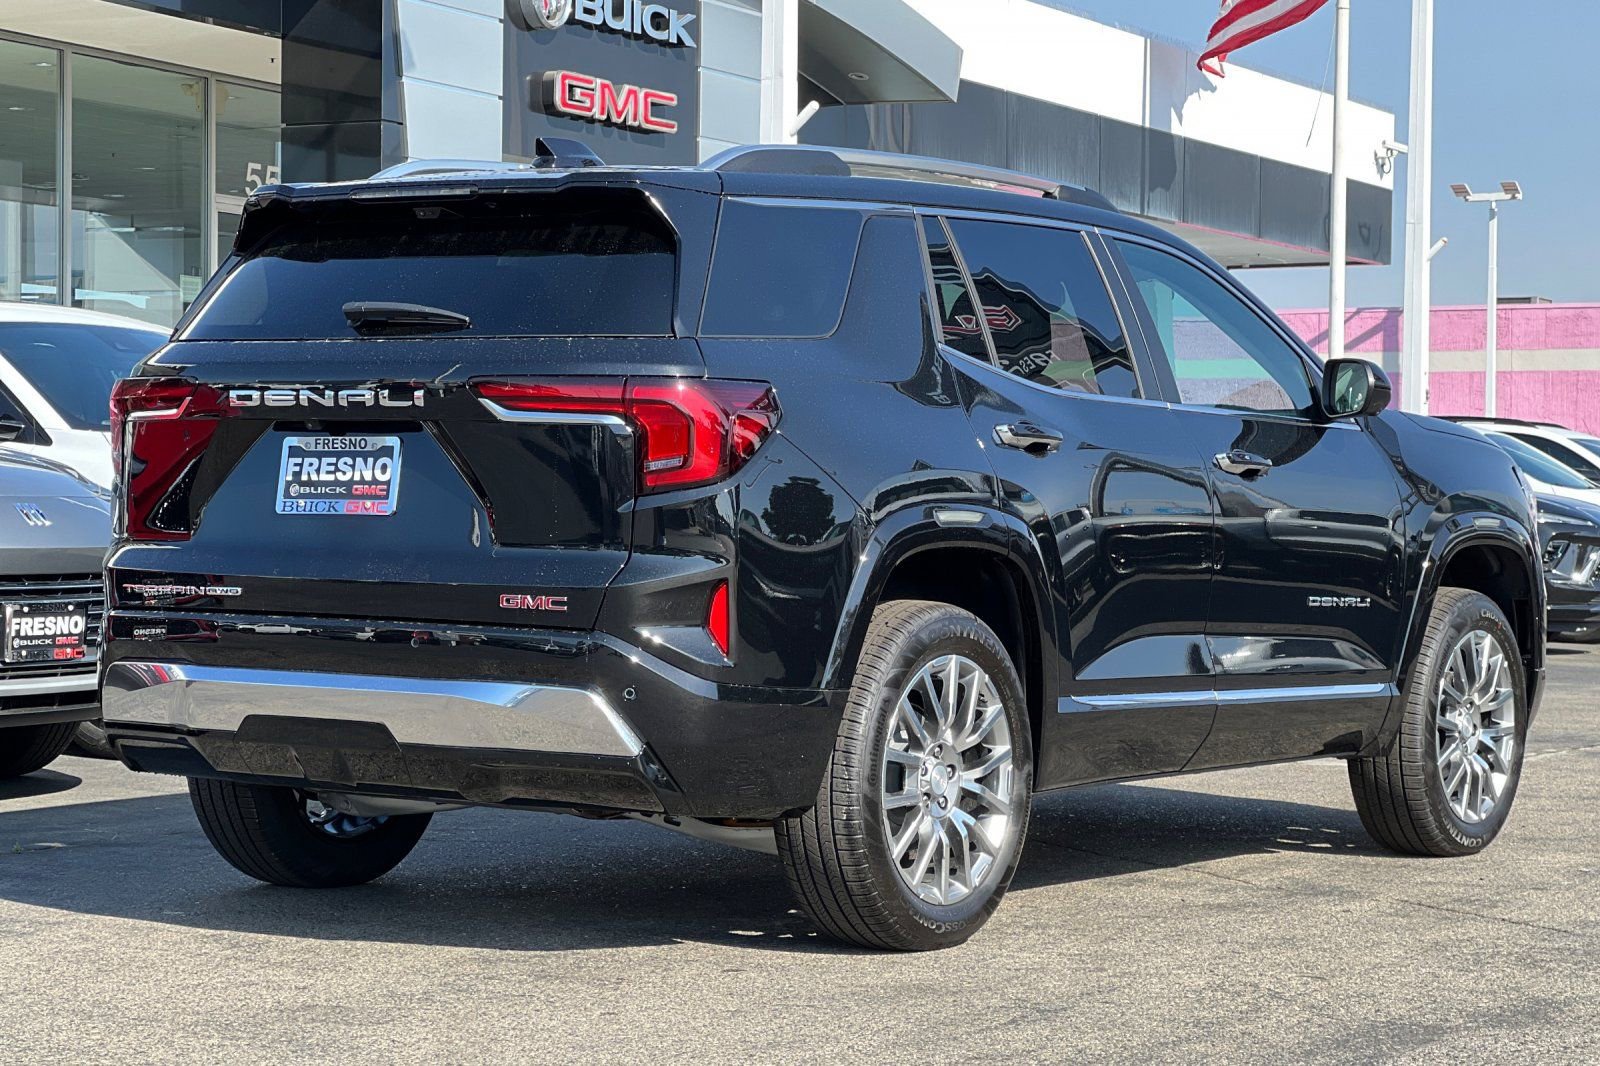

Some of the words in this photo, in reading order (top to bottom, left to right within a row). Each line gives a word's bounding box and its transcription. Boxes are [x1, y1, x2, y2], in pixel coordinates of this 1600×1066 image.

[575, 0, 697, 48] BUICK
[556, 70, 678, 134] GMC
[229, 389, 425, 407] DENALI
[314, 437, 368, 450] FRESNO
[286, 457, 393, 481] FRESNO
[300, 486, 347, 495] BUICK
[352, 484, 387, 496] GMC
[281, 500, 339, 513] BUICK
[343, 501, 389, 514] GMC
[499, 594, 568, 611] GMC
[1308, 596, 1371, 607] DENALI
[11, 616, 83, 636] FRESNO
[19, 638, 53, 646] BUICK
[55, 635, 79, 645] GMC
[53, 647, 84, 659] GMC
